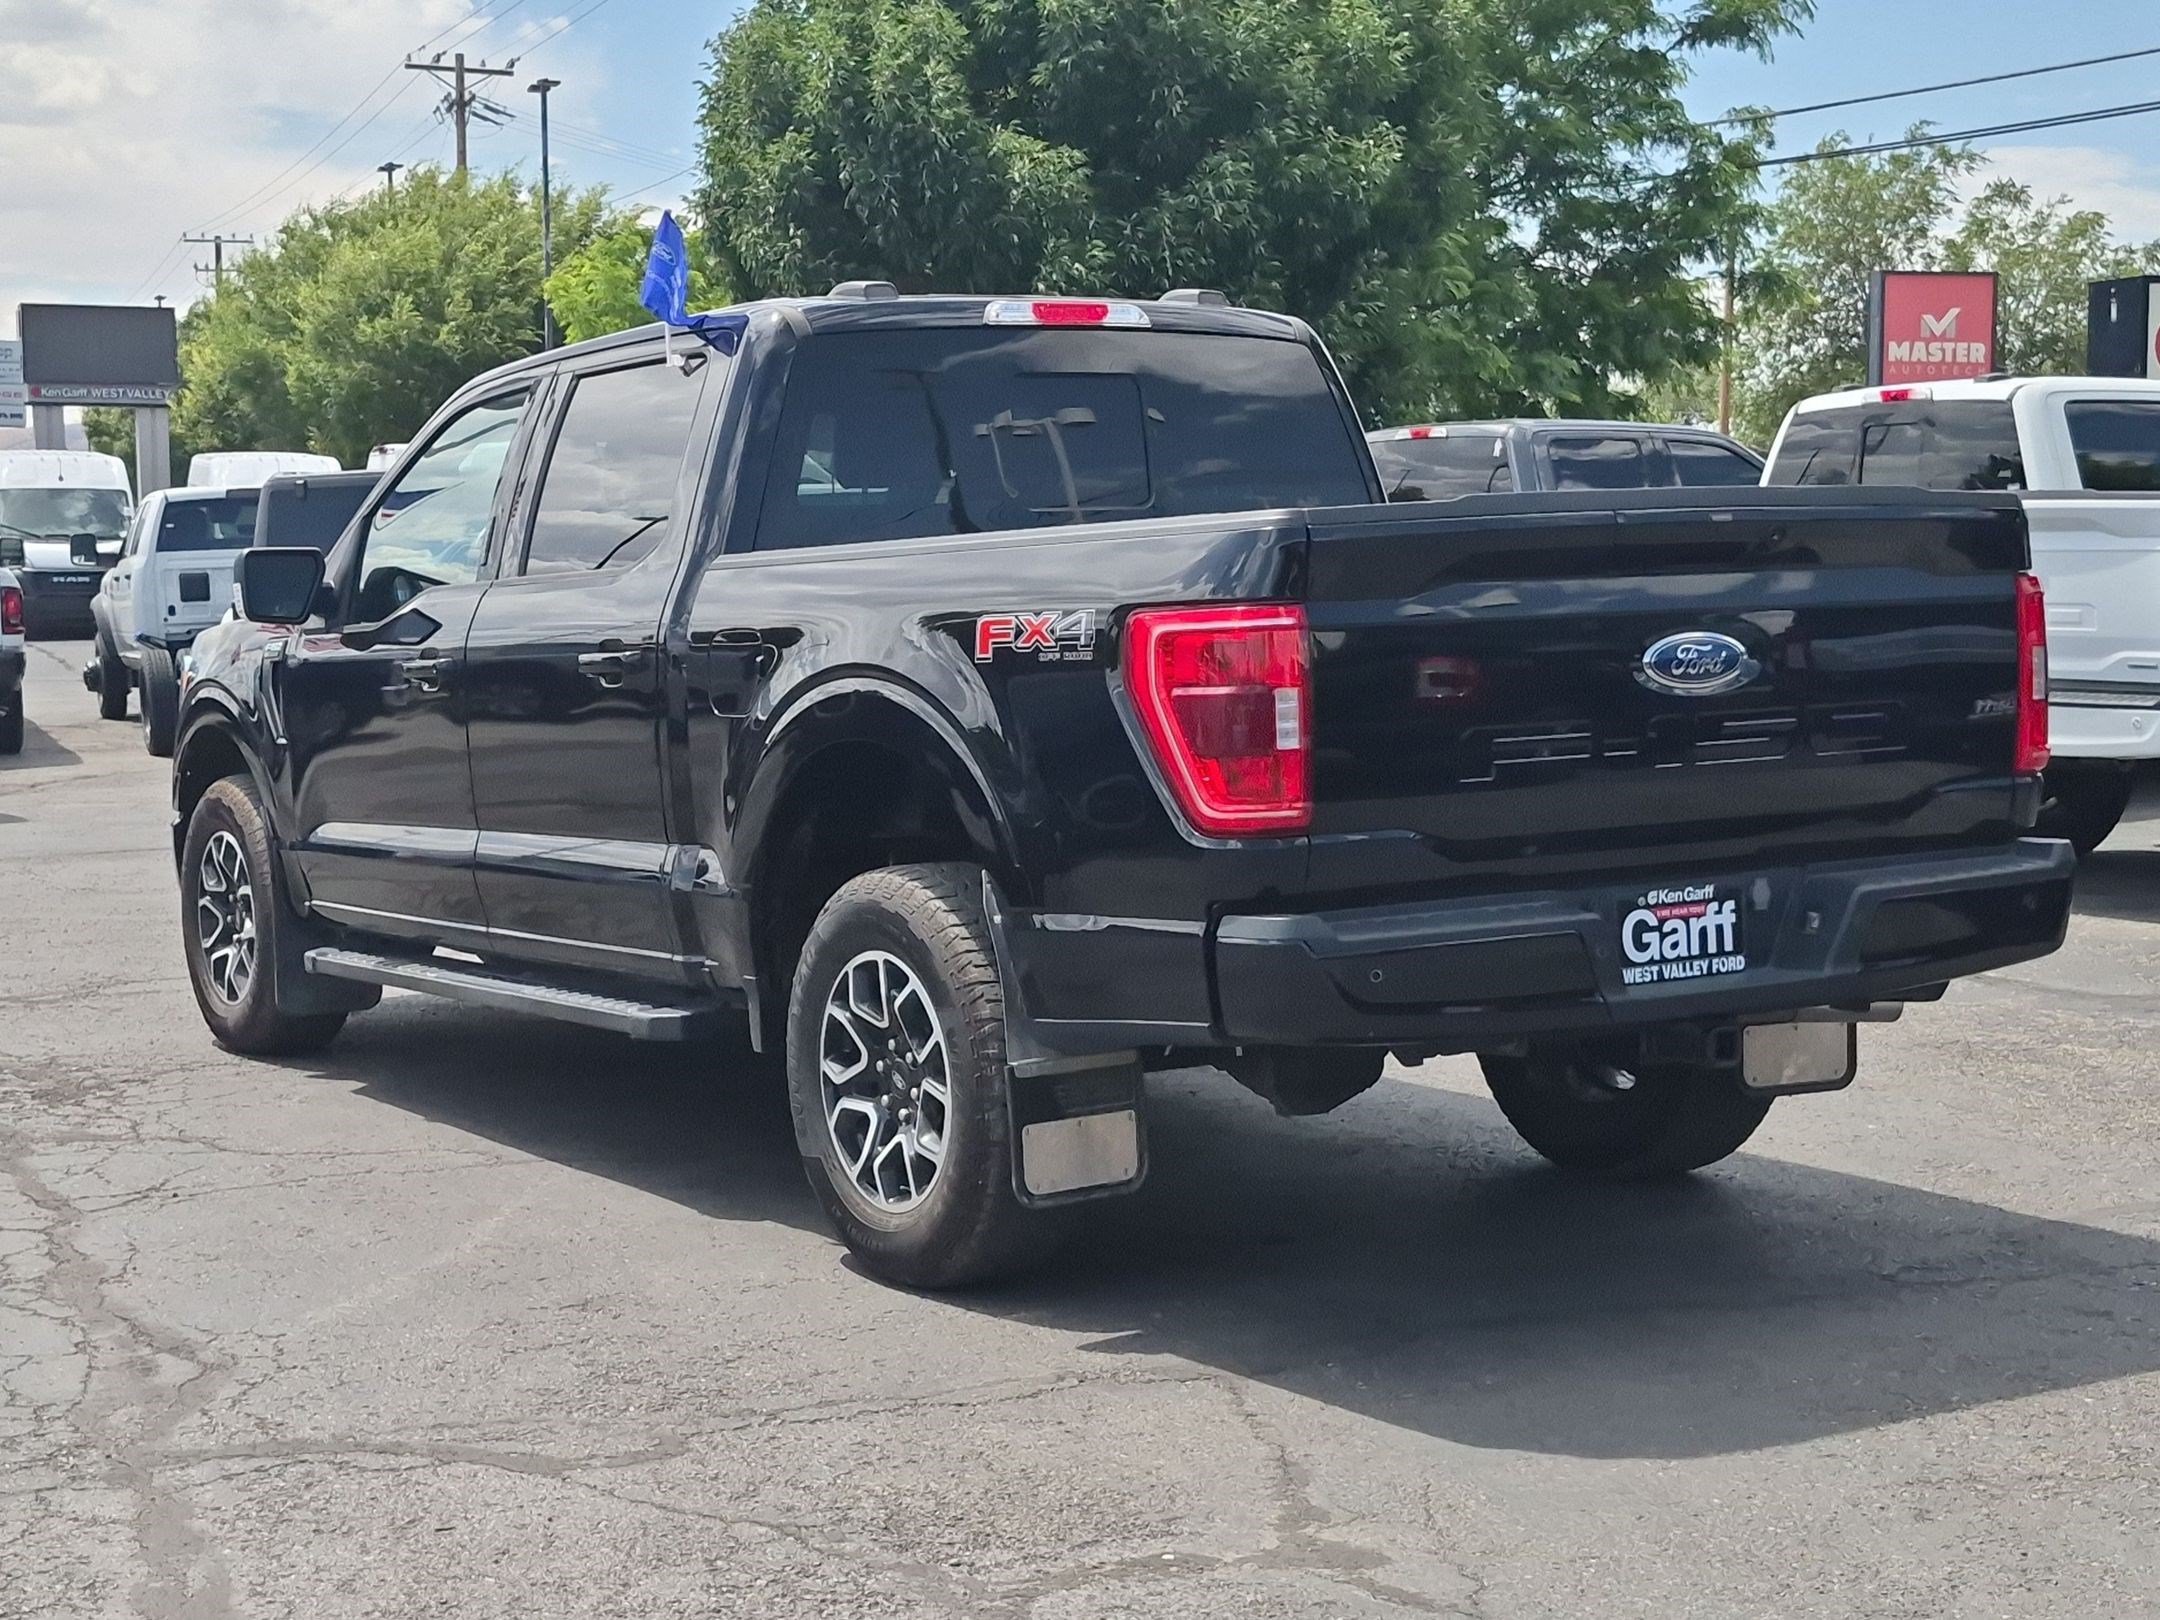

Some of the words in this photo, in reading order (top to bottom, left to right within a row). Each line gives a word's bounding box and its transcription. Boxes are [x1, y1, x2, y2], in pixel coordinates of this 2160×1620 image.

[1888, 341, 1986, 363] MASTER
[1889, 365, 1986, 375] AUTOTECH
[41, 386, 60, 397] Ken
[62, 387, 87, 398] Garff
[91, 387, 124, 399] WEST
[125, 388, 169, 400] VALLEY
[975, 608, 1096, 663] FX4
[1671, 644, 1727, 676] Ford
[1659, 889, 1683, 904] Ken
[1684, 884, 1715, 902] Garff
[1622, 900, 1736, 964] Garff
[1622, 965, 1660, 984] WEST
[1662, 959, 1710, 980] VALLEY
[1711, 955, 1746, 975] FORD
